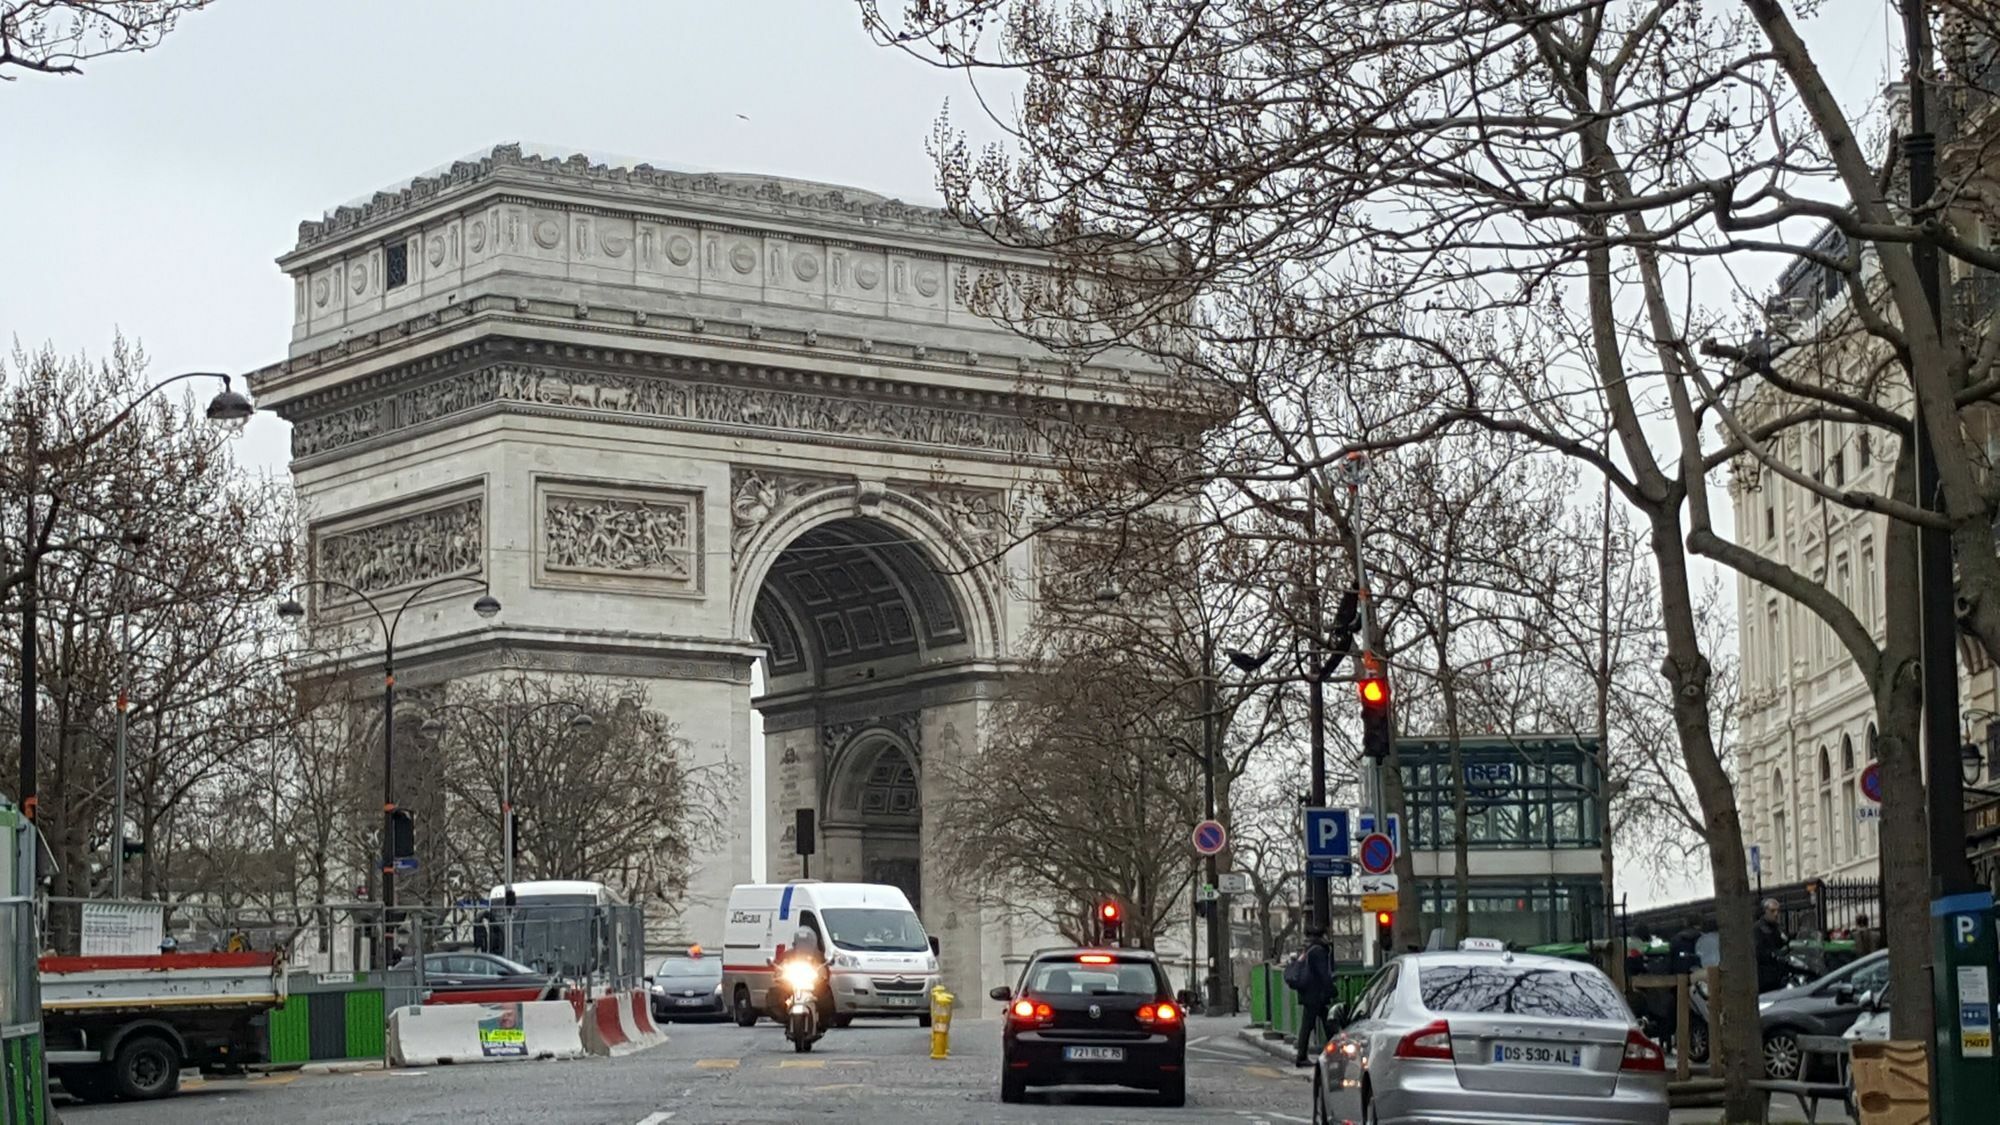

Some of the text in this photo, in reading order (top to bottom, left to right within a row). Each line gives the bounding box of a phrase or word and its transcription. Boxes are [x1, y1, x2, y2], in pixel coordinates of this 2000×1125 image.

[1472, 763, 1512, 781] RER
[1318, 817, 1339, 849] P
[1956, 915, 1975, 944] P
[1473, 941, 1495, 949] TAXI
[1503, 1046, 1571, 1064] DS-530-AL
